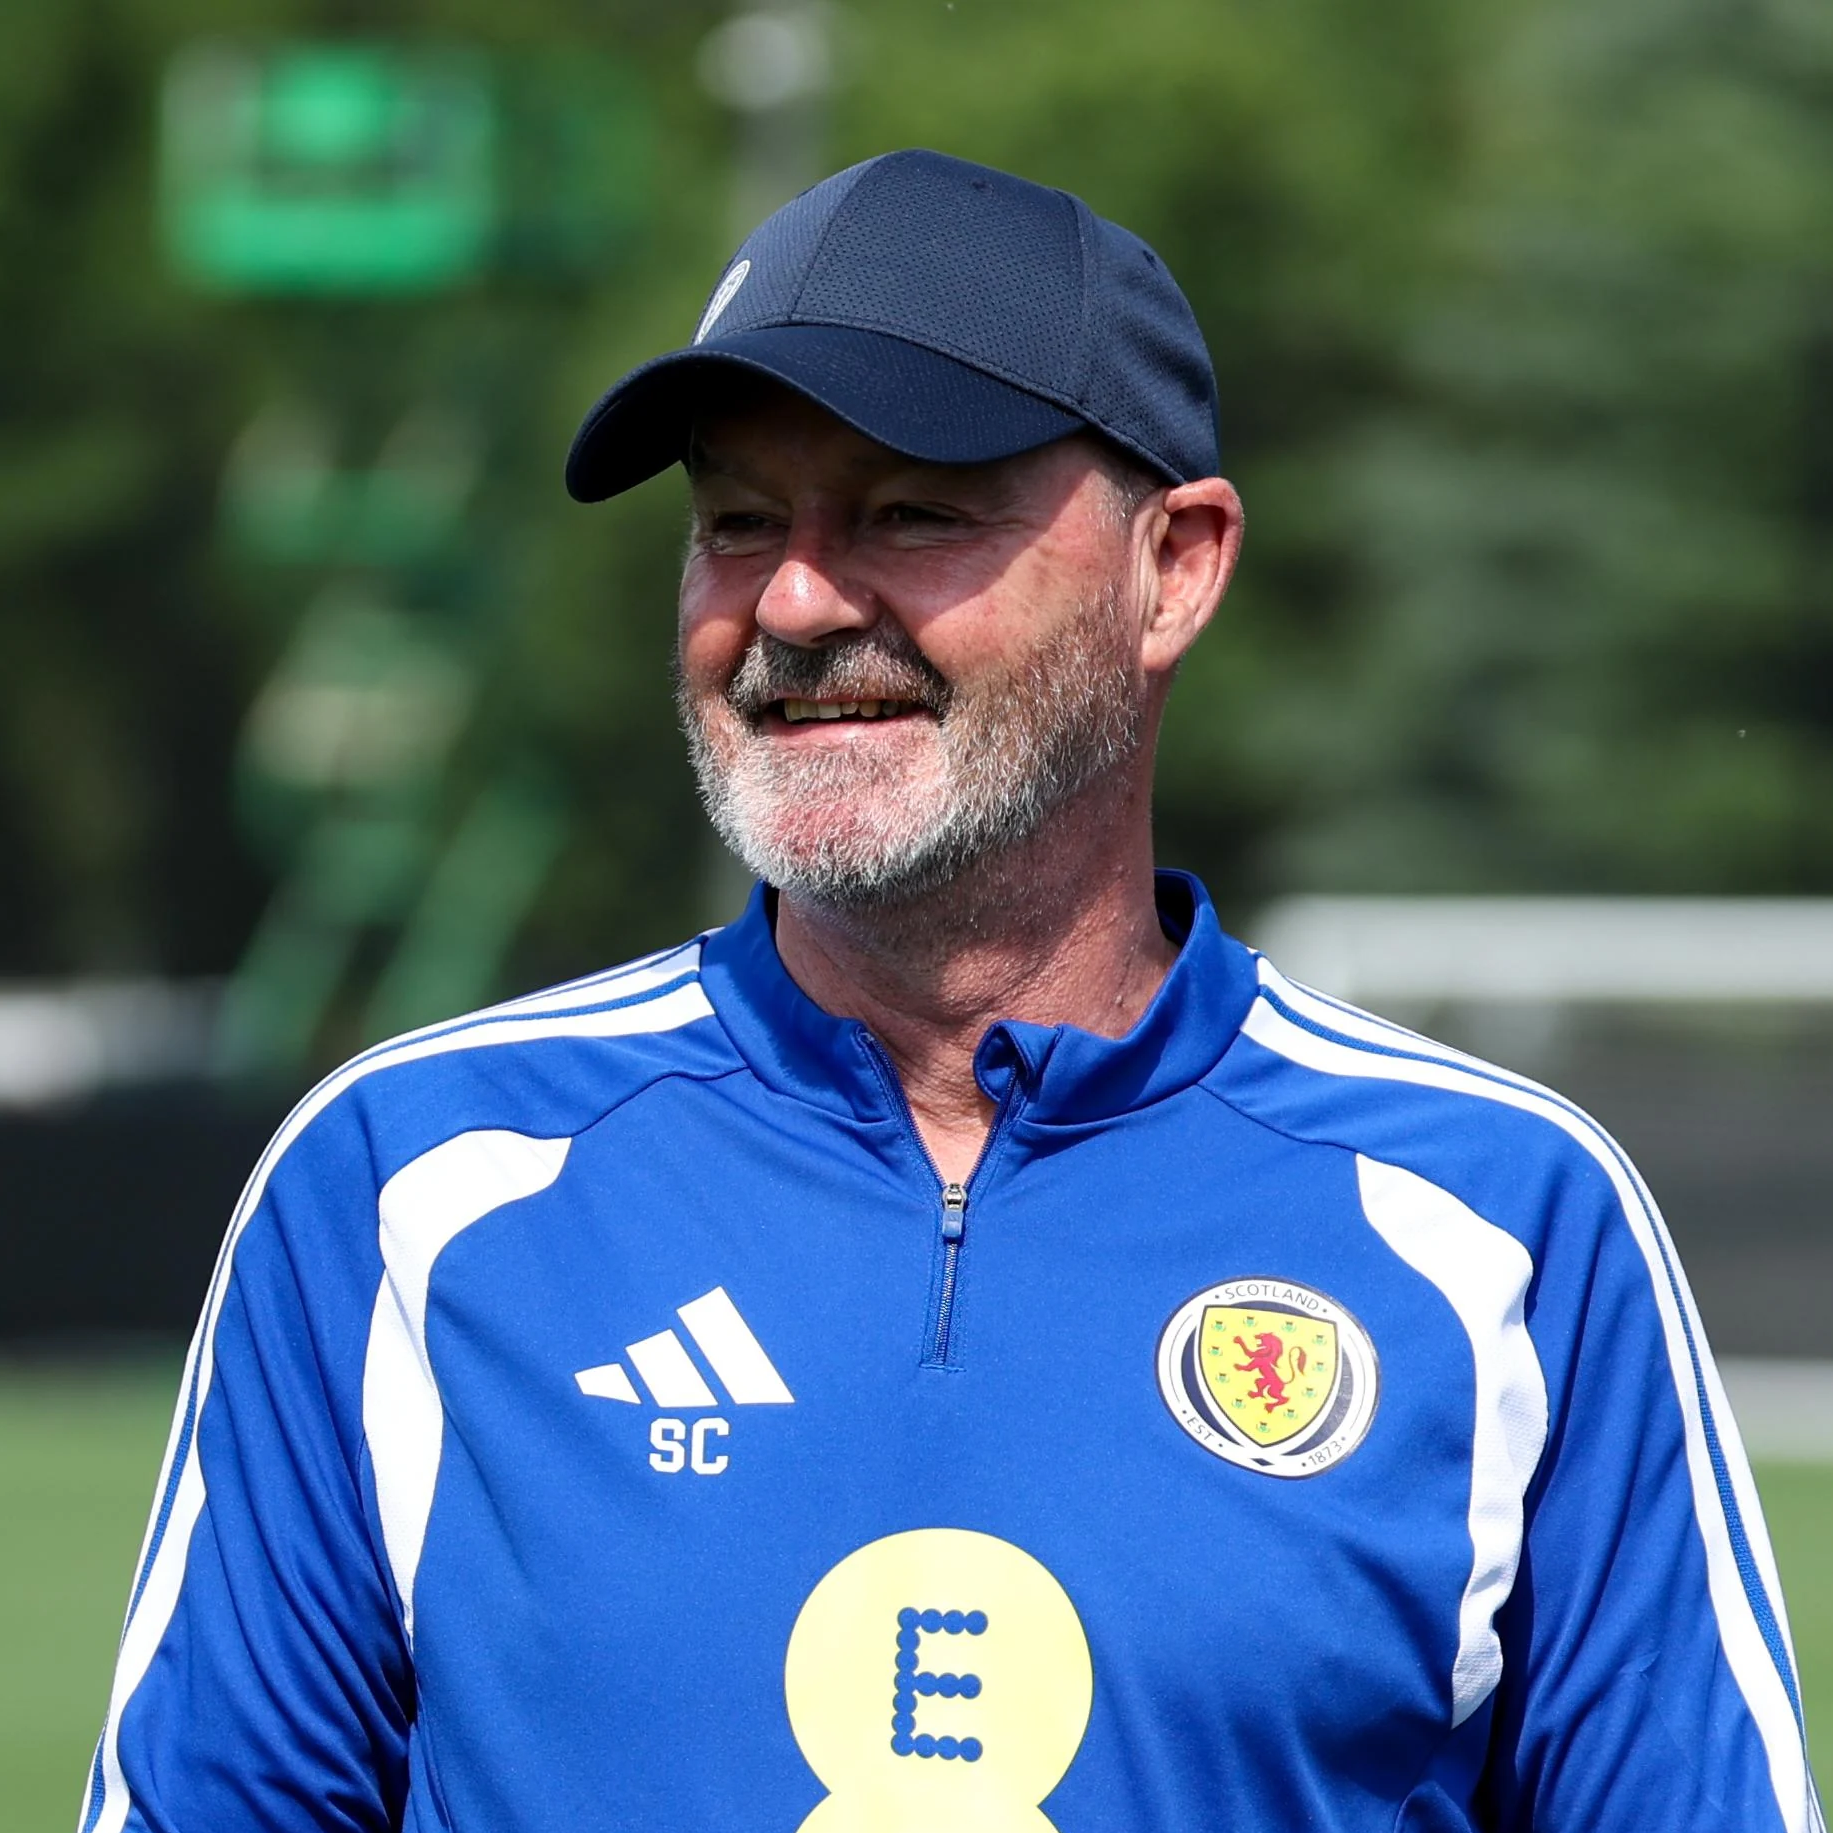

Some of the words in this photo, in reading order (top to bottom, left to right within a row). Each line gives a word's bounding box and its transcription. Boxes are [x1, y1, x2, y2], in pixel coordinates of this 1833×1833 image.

[1224, 1284, 1320, 1311] SCOTLAND
[1186, 1416, 1215, 1442] EST
[649, 1417, 730, 1475] SC
[1308, 1440, 1343, 1466] 1873
